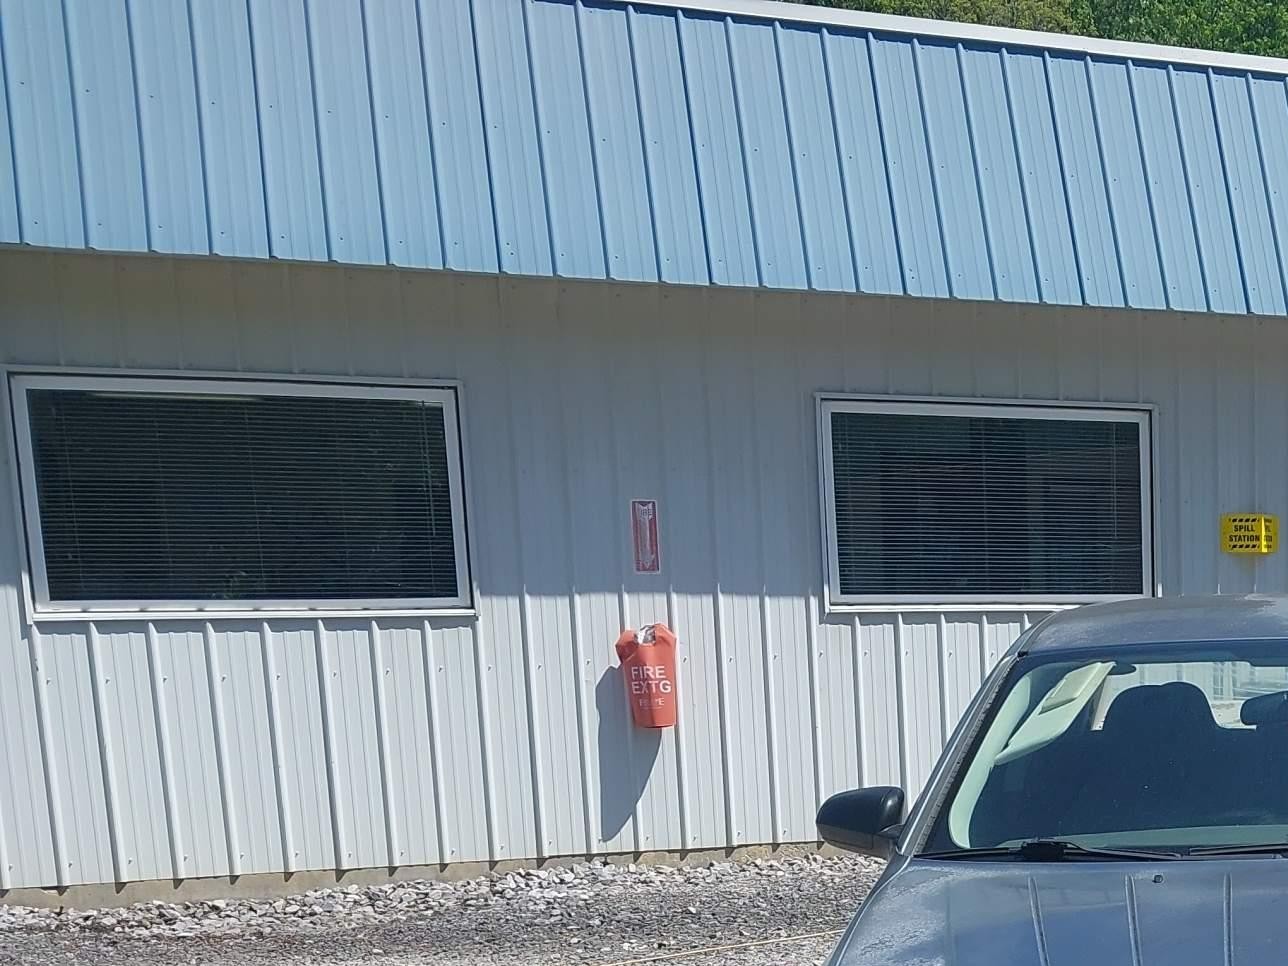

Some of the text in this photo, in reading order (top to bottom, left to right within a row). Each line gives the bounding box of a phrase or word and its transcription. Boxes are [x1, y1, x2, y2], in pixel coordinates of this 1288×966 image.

[1233, 524, 1255, 532] SPILL
[1228, 534, 1260, 542] STATION
[631, 665, 667, 680] FIRE
[631, 680, 672, 694] EXTG
